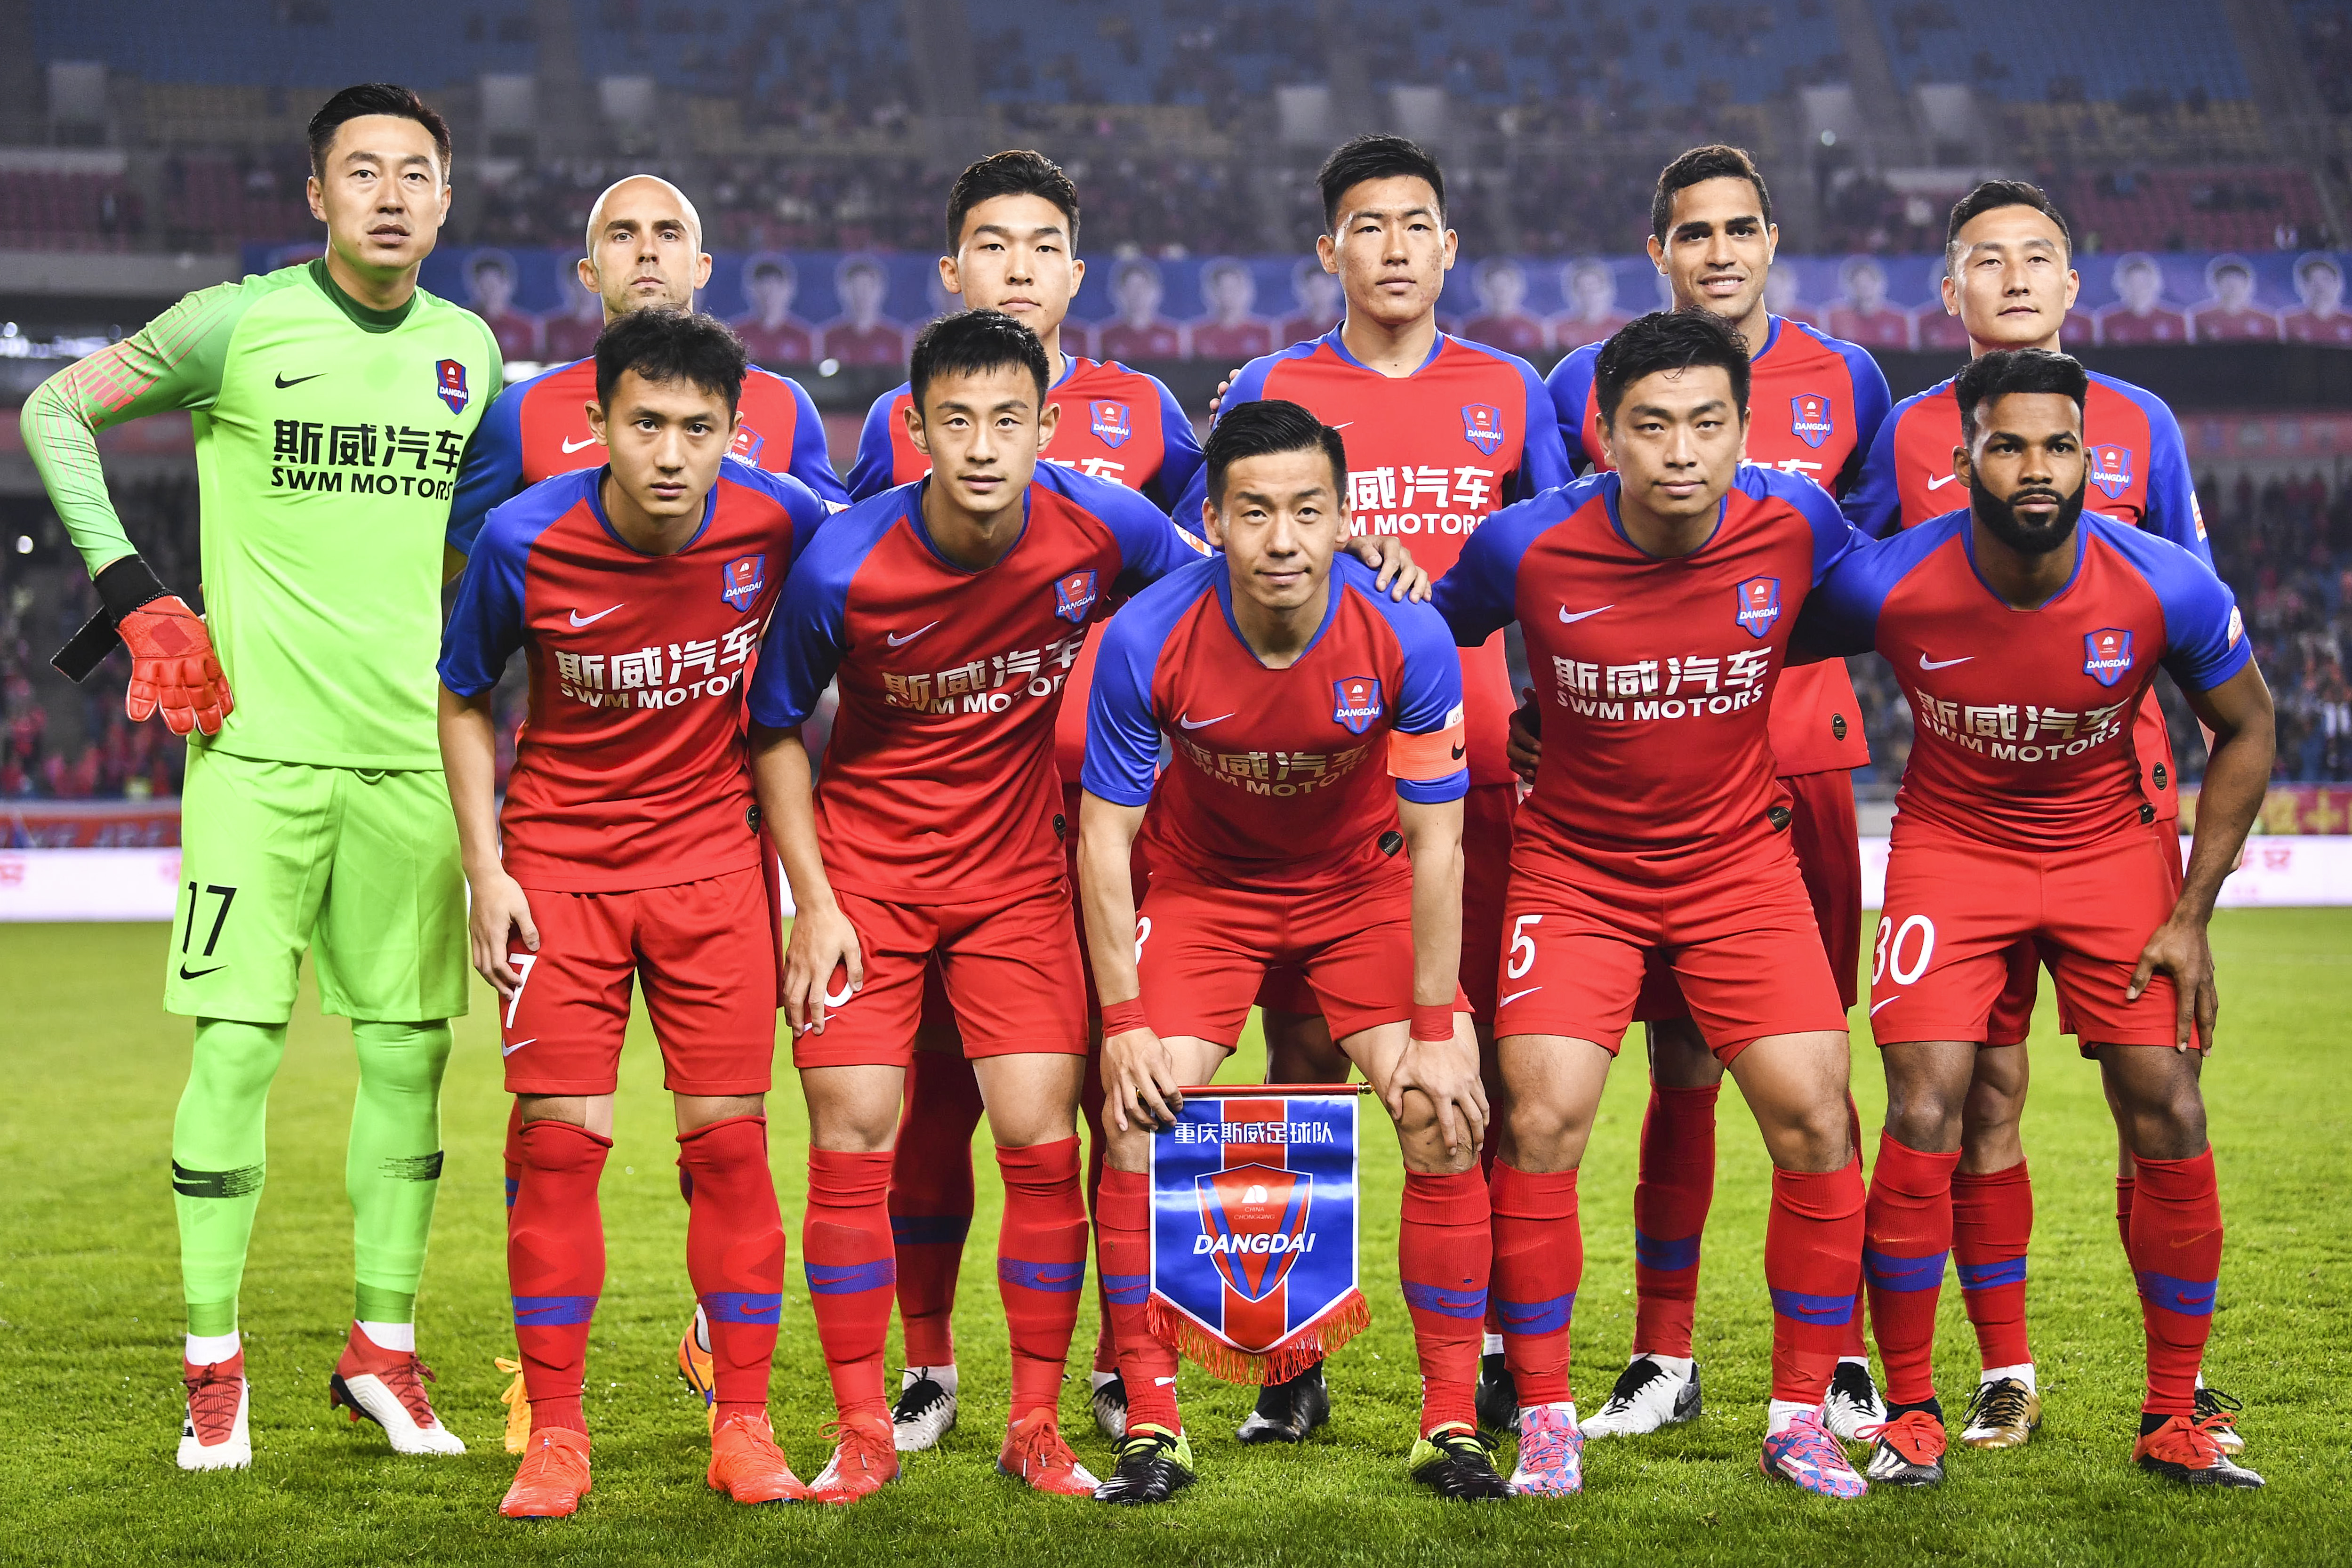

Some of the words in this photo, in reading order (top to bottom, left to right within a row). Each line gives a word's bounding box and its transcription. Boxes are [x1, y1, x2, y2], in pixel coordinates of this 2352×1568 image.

[439, 386, 467, 400] DANGDAI
[1093, 423, 1130, 436] DANGDAI
[1467, 429, 1501, 440] DANGDAI
[1794, 422, 1831, 432] DANGDAI
[273, 419, 464, 474] 斯威汽车
[723, 450, 757, 468] ANGDAI
[271, 467, 343, 492] SWM
[351, 473, 453, 500] MOTORS
[1348, 465, 1494, 512] 威汽车
[2093, 471, 2130, 484] DANGDAI
[725, 580, 762, 598] DANGDAI
[1058, 592, 1097, 613] DANGDAI
[1739, 606, 1778, 620] DANGDAI
[555, 618, 760, 691] 斯威汽车
[881, 627, 1085, 702] 斯威汽车
[2087, 657, 2130, 669] DANGDAI
[561, 683, 629, 709] SWM
[637, 668, 742, 709] MOTOR
[1551, 645, 1772, 699] 斯威汽车
[1336, 706, 1380, 718] DANGDAI
[1557, 690, 1624, 721] SWM
[1633, 683, 1764, 721] MOTORS
[1914, 686, 2130, 741] 斯威汽车
[1921, 711, 1983, 754] SWM
[1991, 720, 2121, 762] MOTORS
[182, 881, 238, 957] 17
[1507, 914, 1543, 979] 5
[1871, 914, 1935, 986] 30
[506, 952, 538, 1029] 7
[1174, 1121, 1334, 1144] 重庆斯威足球队
[1192, 1232, 1316, 1255] DANGDAI
